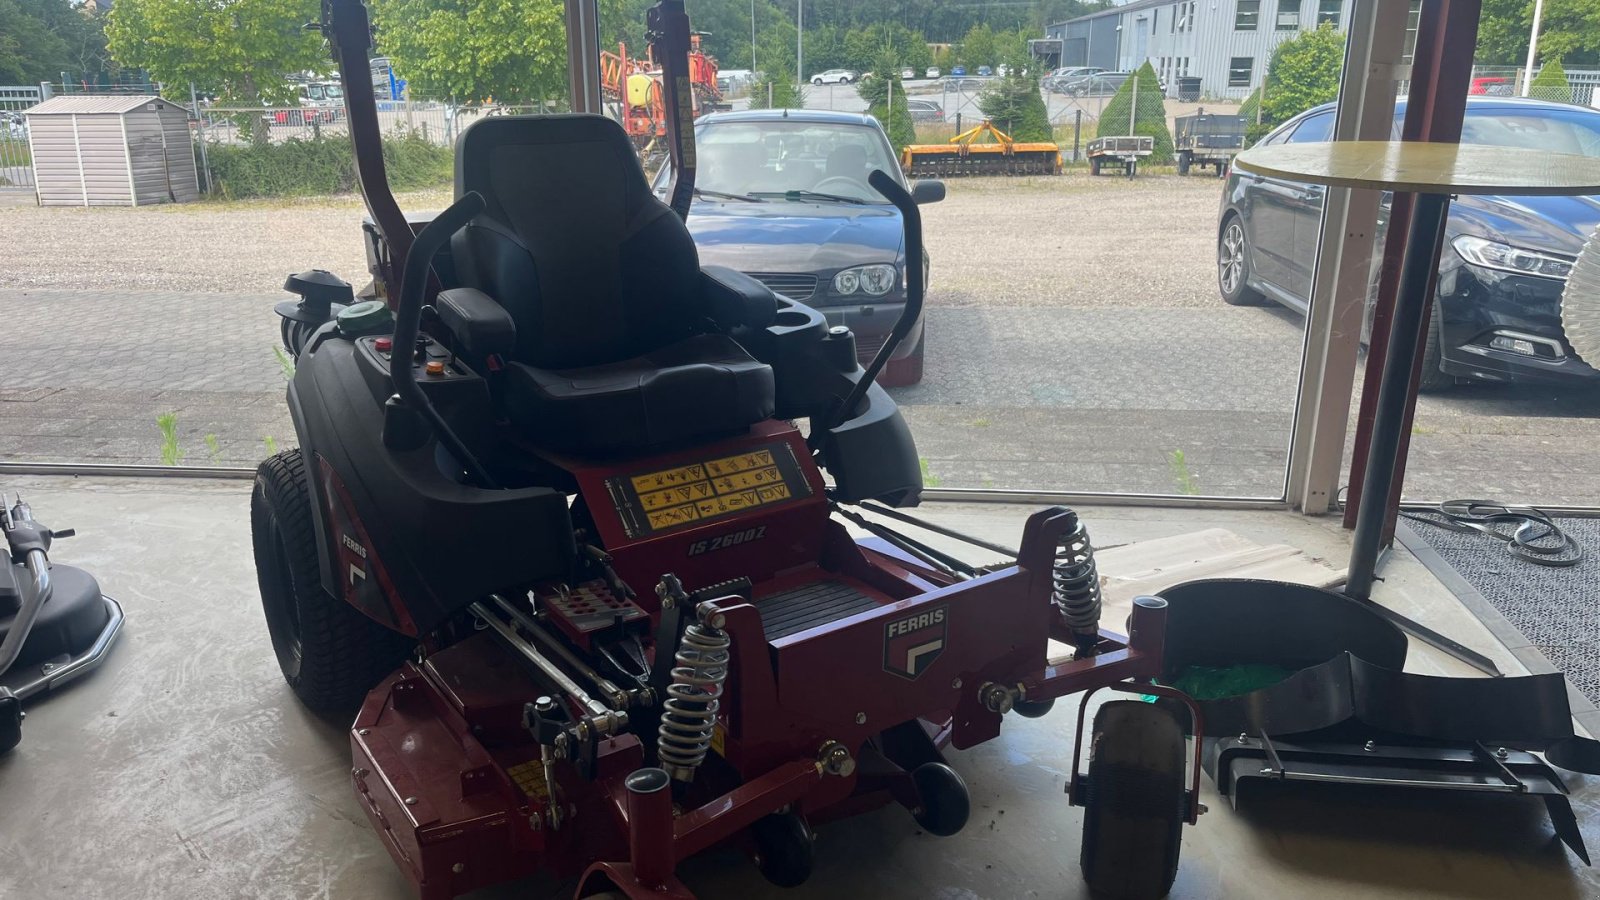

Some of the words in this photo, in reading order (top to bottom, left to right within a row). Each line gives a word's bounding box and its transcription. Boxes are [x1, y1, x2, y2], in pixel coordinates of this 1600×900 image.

[343, 534, 368, 559] FERRIS
[688, 540, 708, 557] IS
[710, 525, 767, 551] 2600Z
[888, 609, 944, 638] FERRIS
